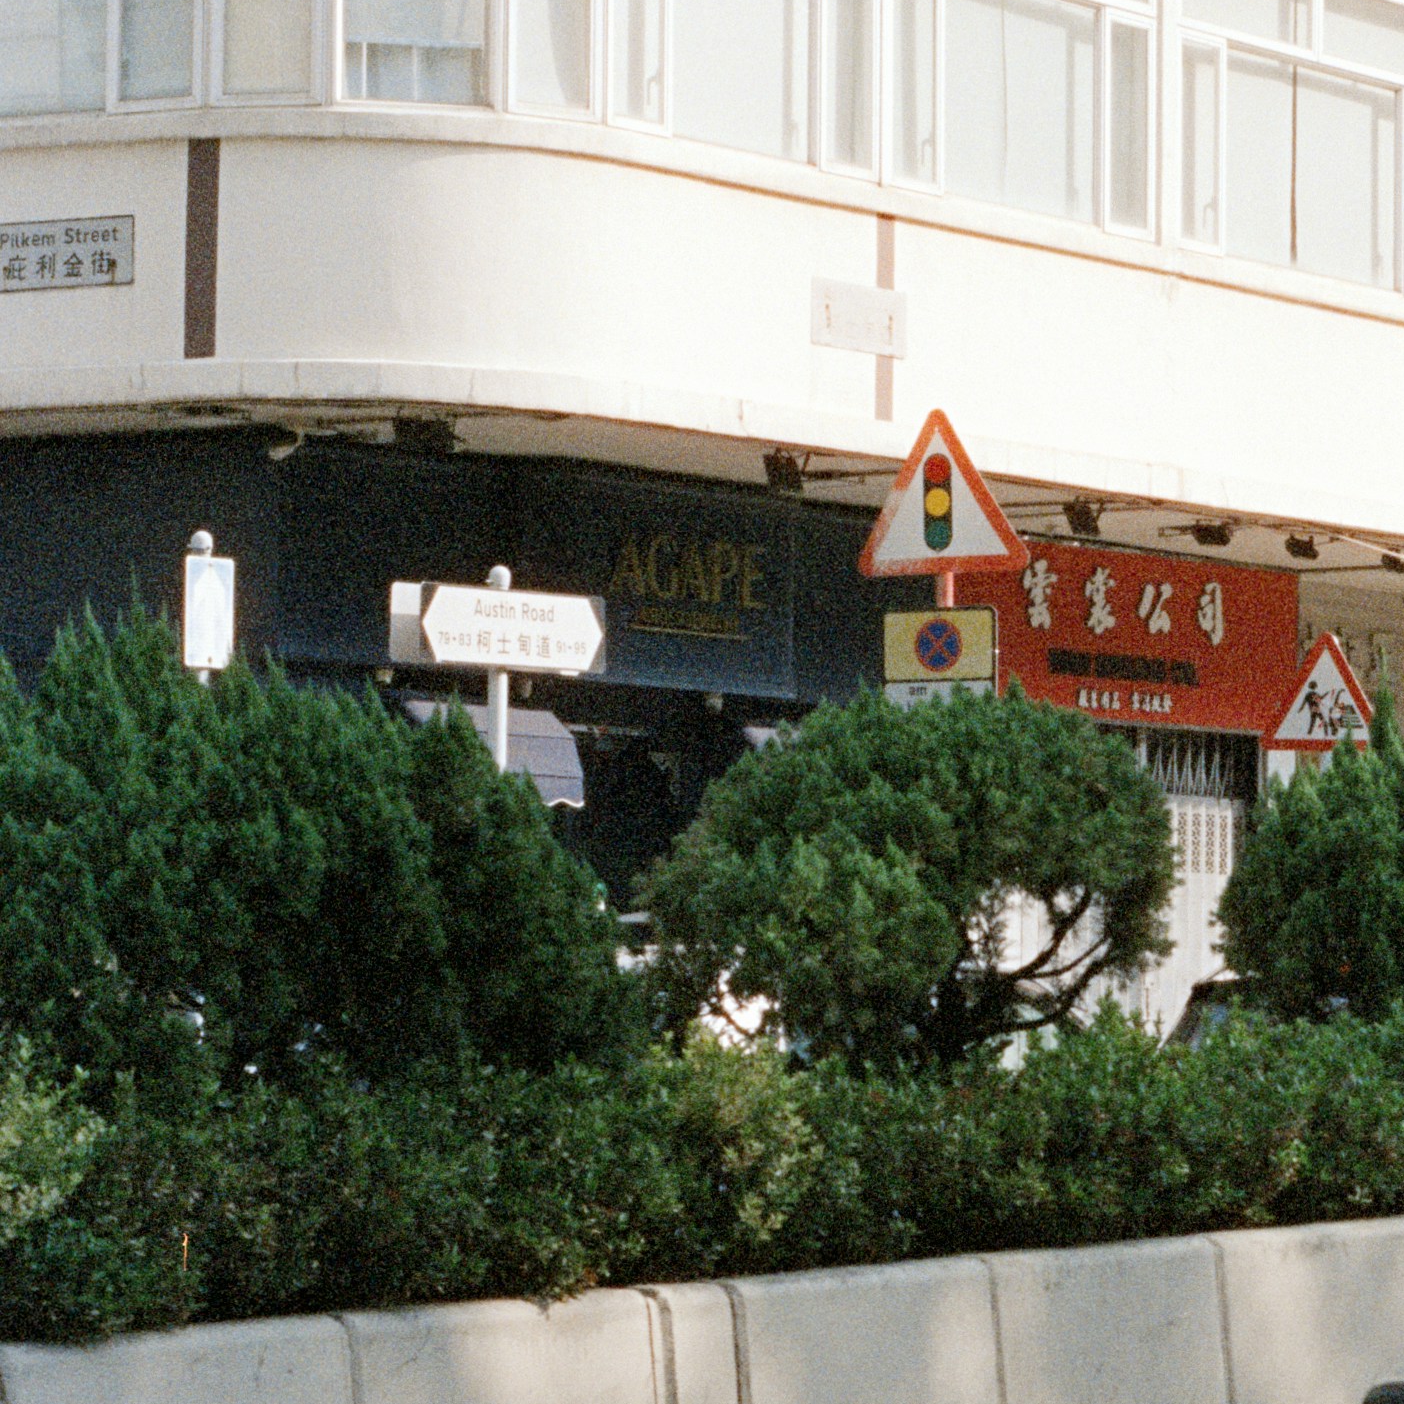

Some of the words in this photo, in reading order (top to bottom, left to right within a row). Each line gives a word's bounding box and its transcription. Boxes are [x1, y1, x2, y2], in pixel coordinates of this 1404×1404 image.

[64, 226, 119, 245] Street
[609, 533, 768, 608] AGAPE
[474, 598, 517, 620] Austin
[521, 603, 555, 623] Road
[477, 629, 551, 658] 柯士甸道
